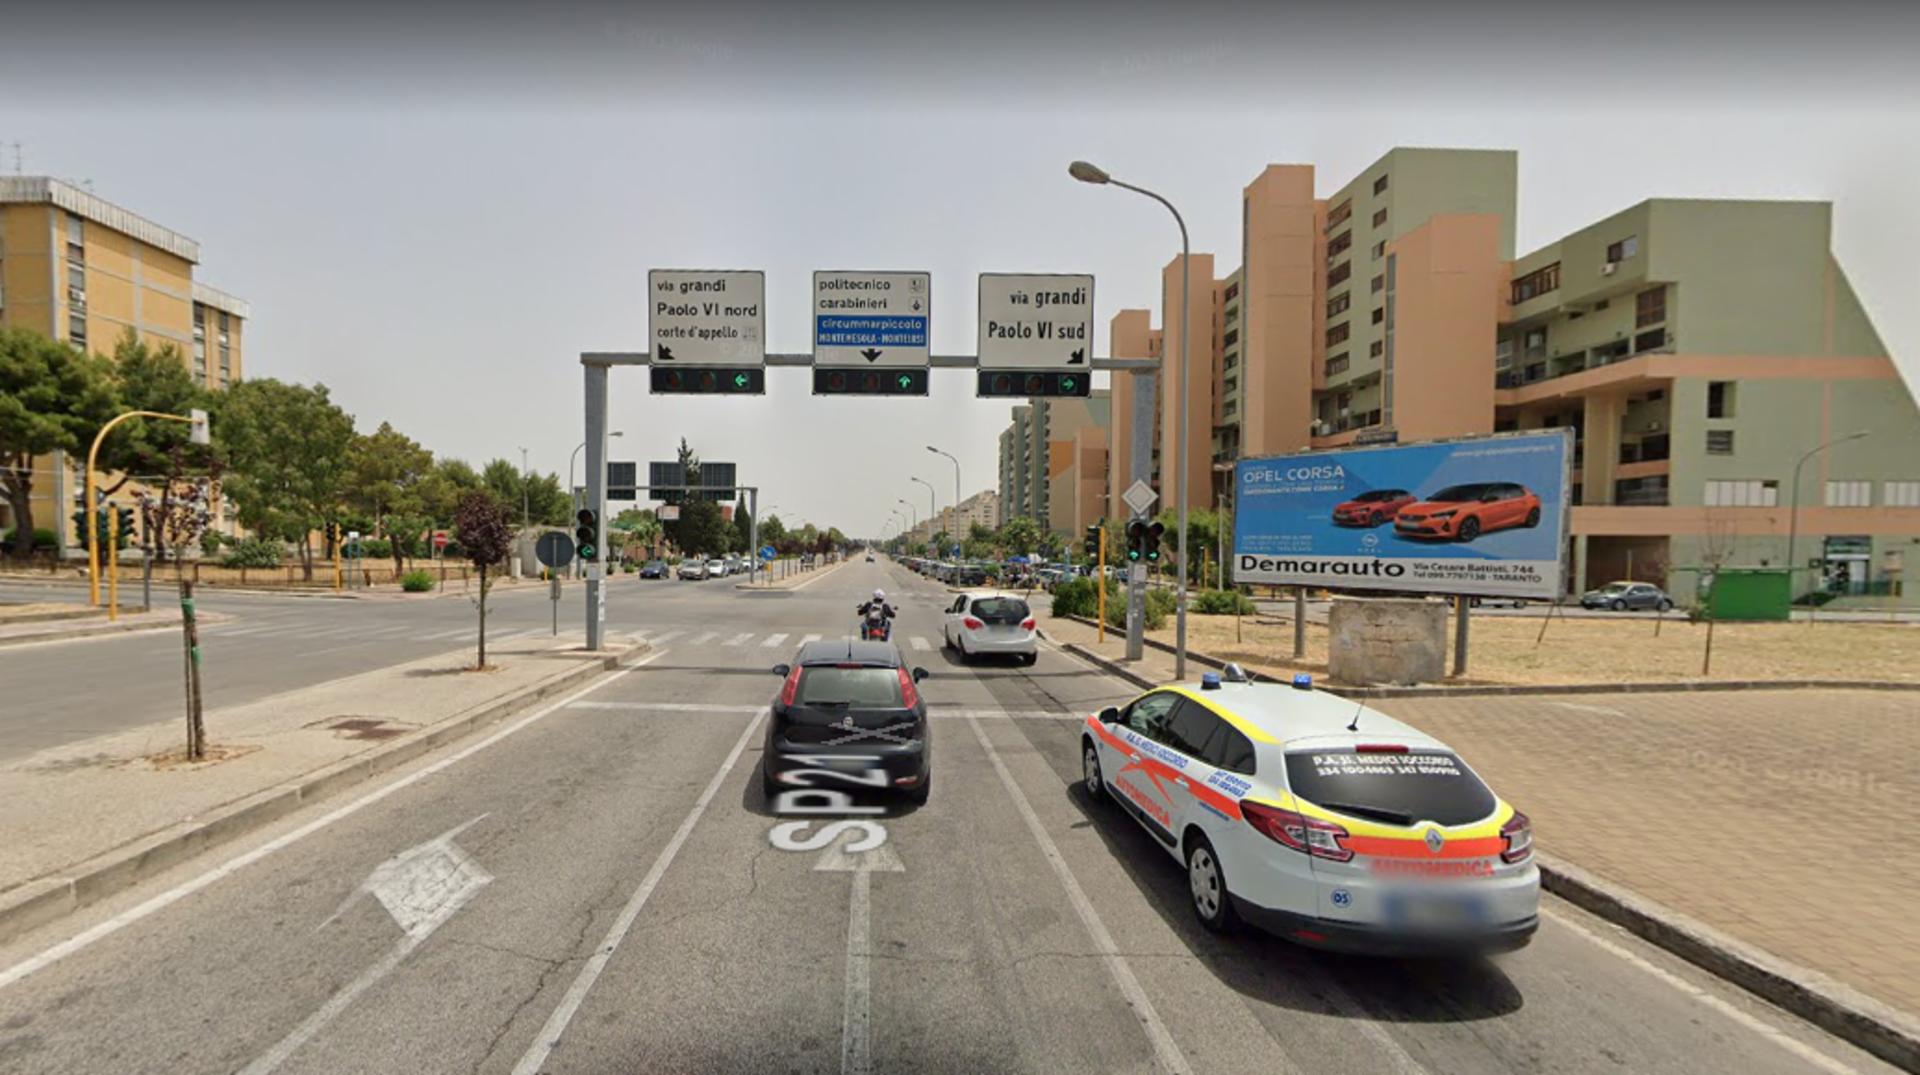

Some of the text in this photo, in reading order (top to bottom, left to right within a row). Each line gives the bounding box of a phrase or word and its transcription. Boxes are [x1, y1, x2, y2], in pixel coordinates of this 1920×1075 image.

[657, 279, 726, 295] via grandi
[819, 279, 891, 292] politecnico
[820, 297, 887, 309] carabinieri
[1009, 287, 1086, 308] via grandi
[657, 302, 757, 317] Paolo VI nord
[822, 318, 922, 331] circummarpiccolo
[988, 321, 1085, 339] Paolo VI sud
[657, 325, 738, 340] corte d'appello
[1243, 464, 1345, 483] OPEL CORSA
[1240, 555, 1405, 578] Demarauto
[1413, 562, 1429, 570] Via
[1413, 570, 1426, 578] Tel
[1493, 574, 1543, 583] TARANTO
[1371, 858, 1495, 878] AUTOMEDICA
